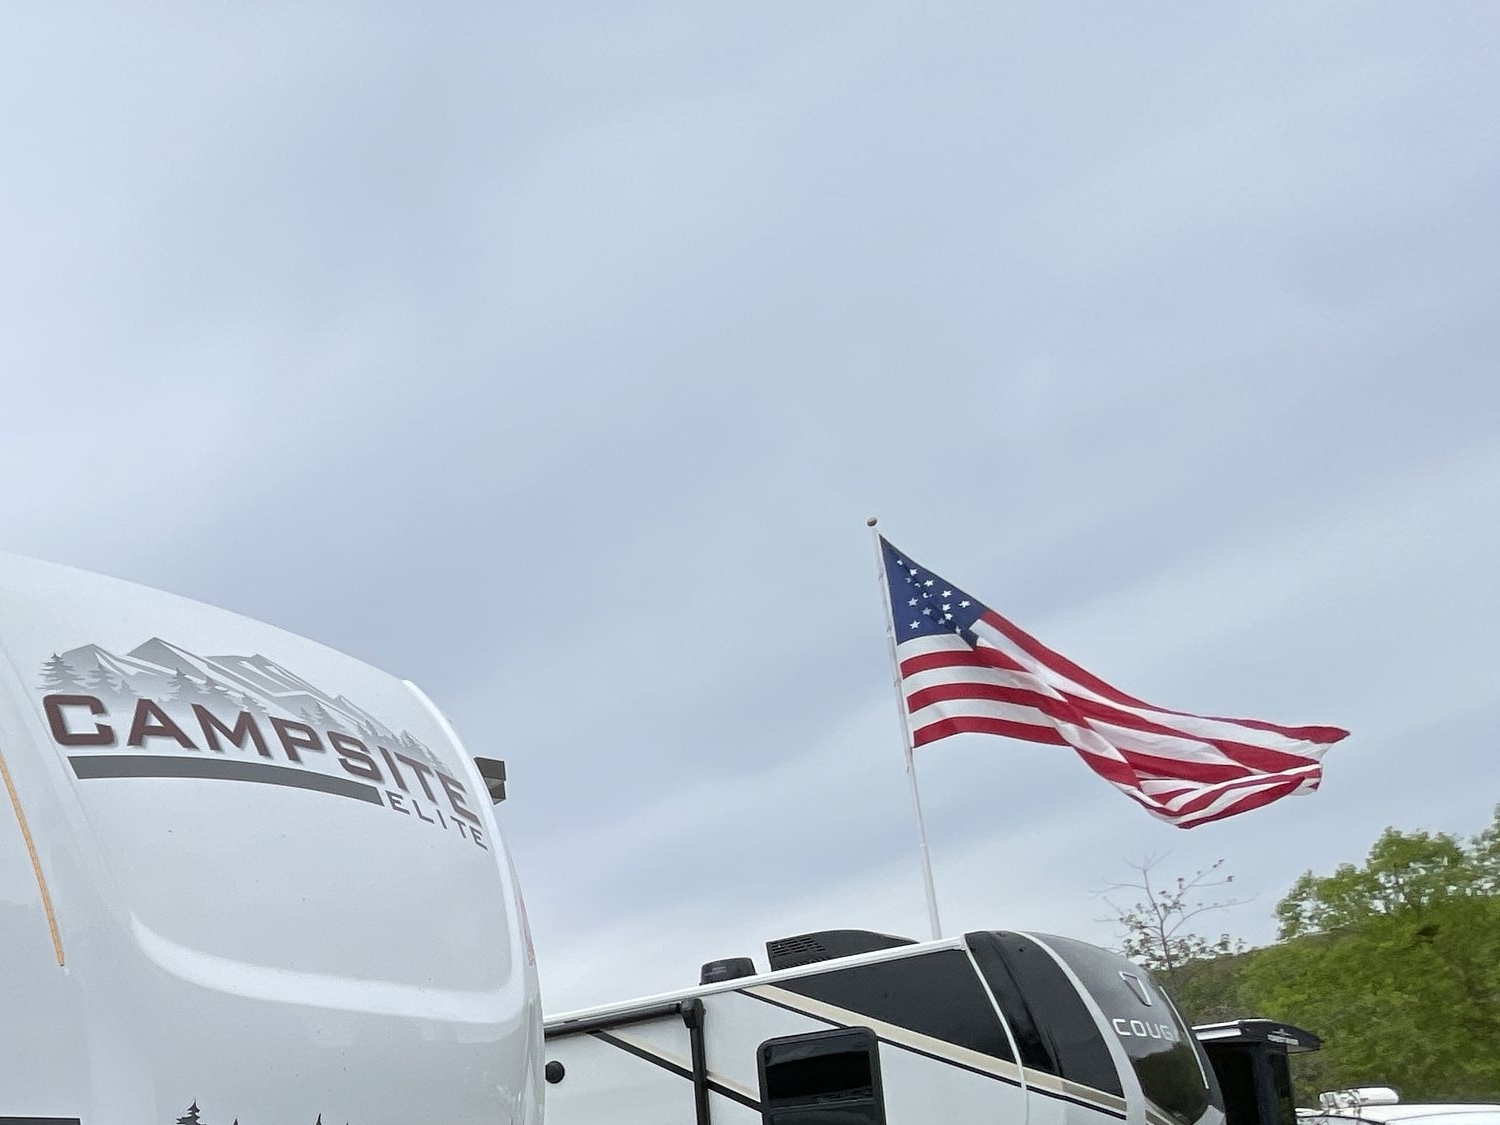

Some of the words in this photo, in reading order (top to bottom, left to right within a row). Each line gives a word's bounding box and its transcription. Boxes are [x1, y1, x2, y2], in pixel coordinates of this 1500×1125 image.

[42, 694, 482, 828] CAMPSITE
[386, 791, 489, 851] ELITE
[1112, 1018, 1177, 1041] COUG
